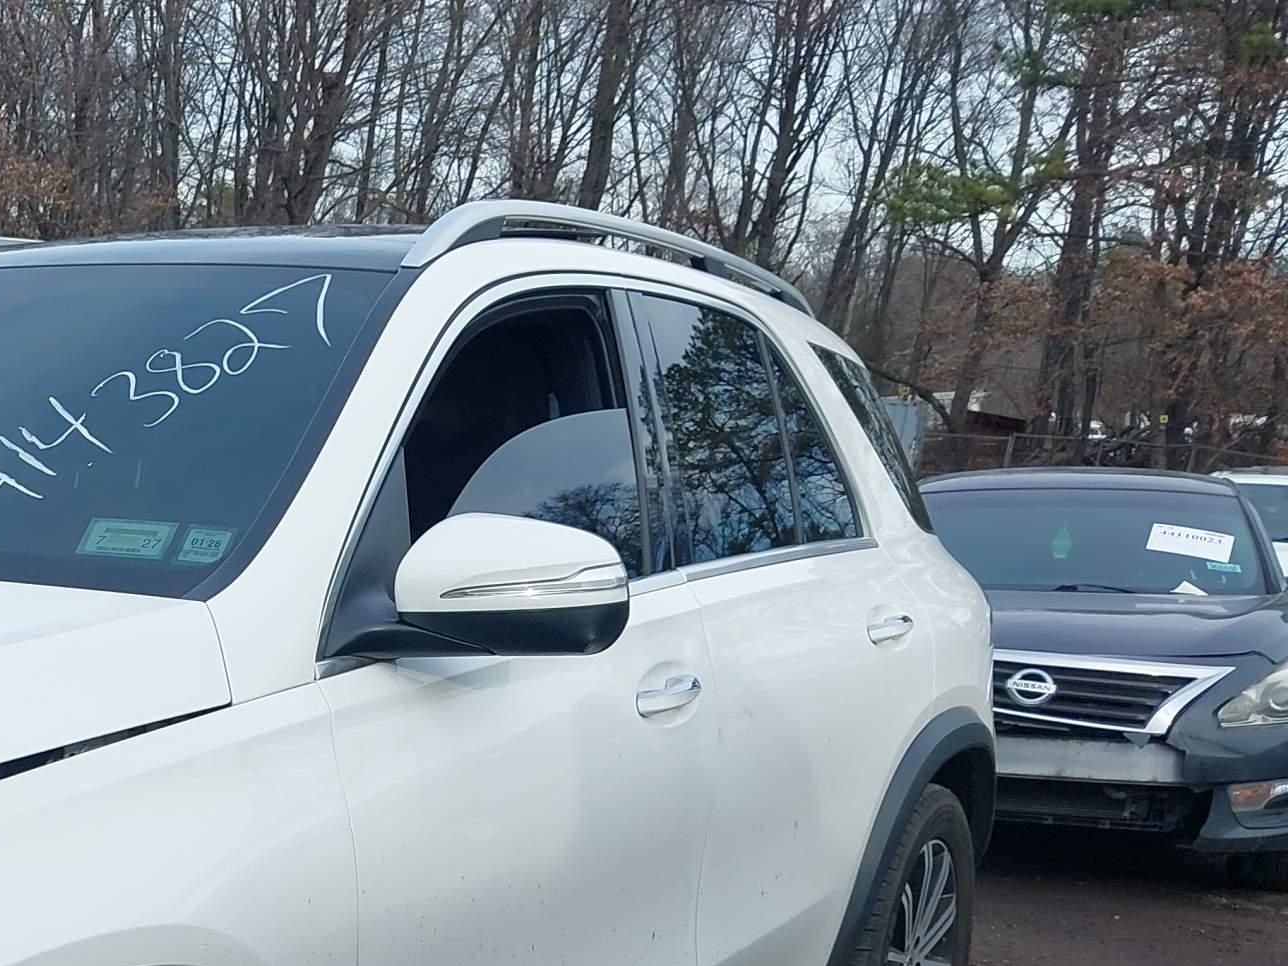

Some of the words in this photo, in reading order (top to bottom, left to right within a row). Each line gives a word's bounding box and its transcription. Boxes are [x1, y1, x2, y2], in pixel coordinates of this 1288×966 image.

[139, 538, 163, 550] 27
[189, 537, 204, 547] 01
[1012, 681, 1052, 691] NISSAN
